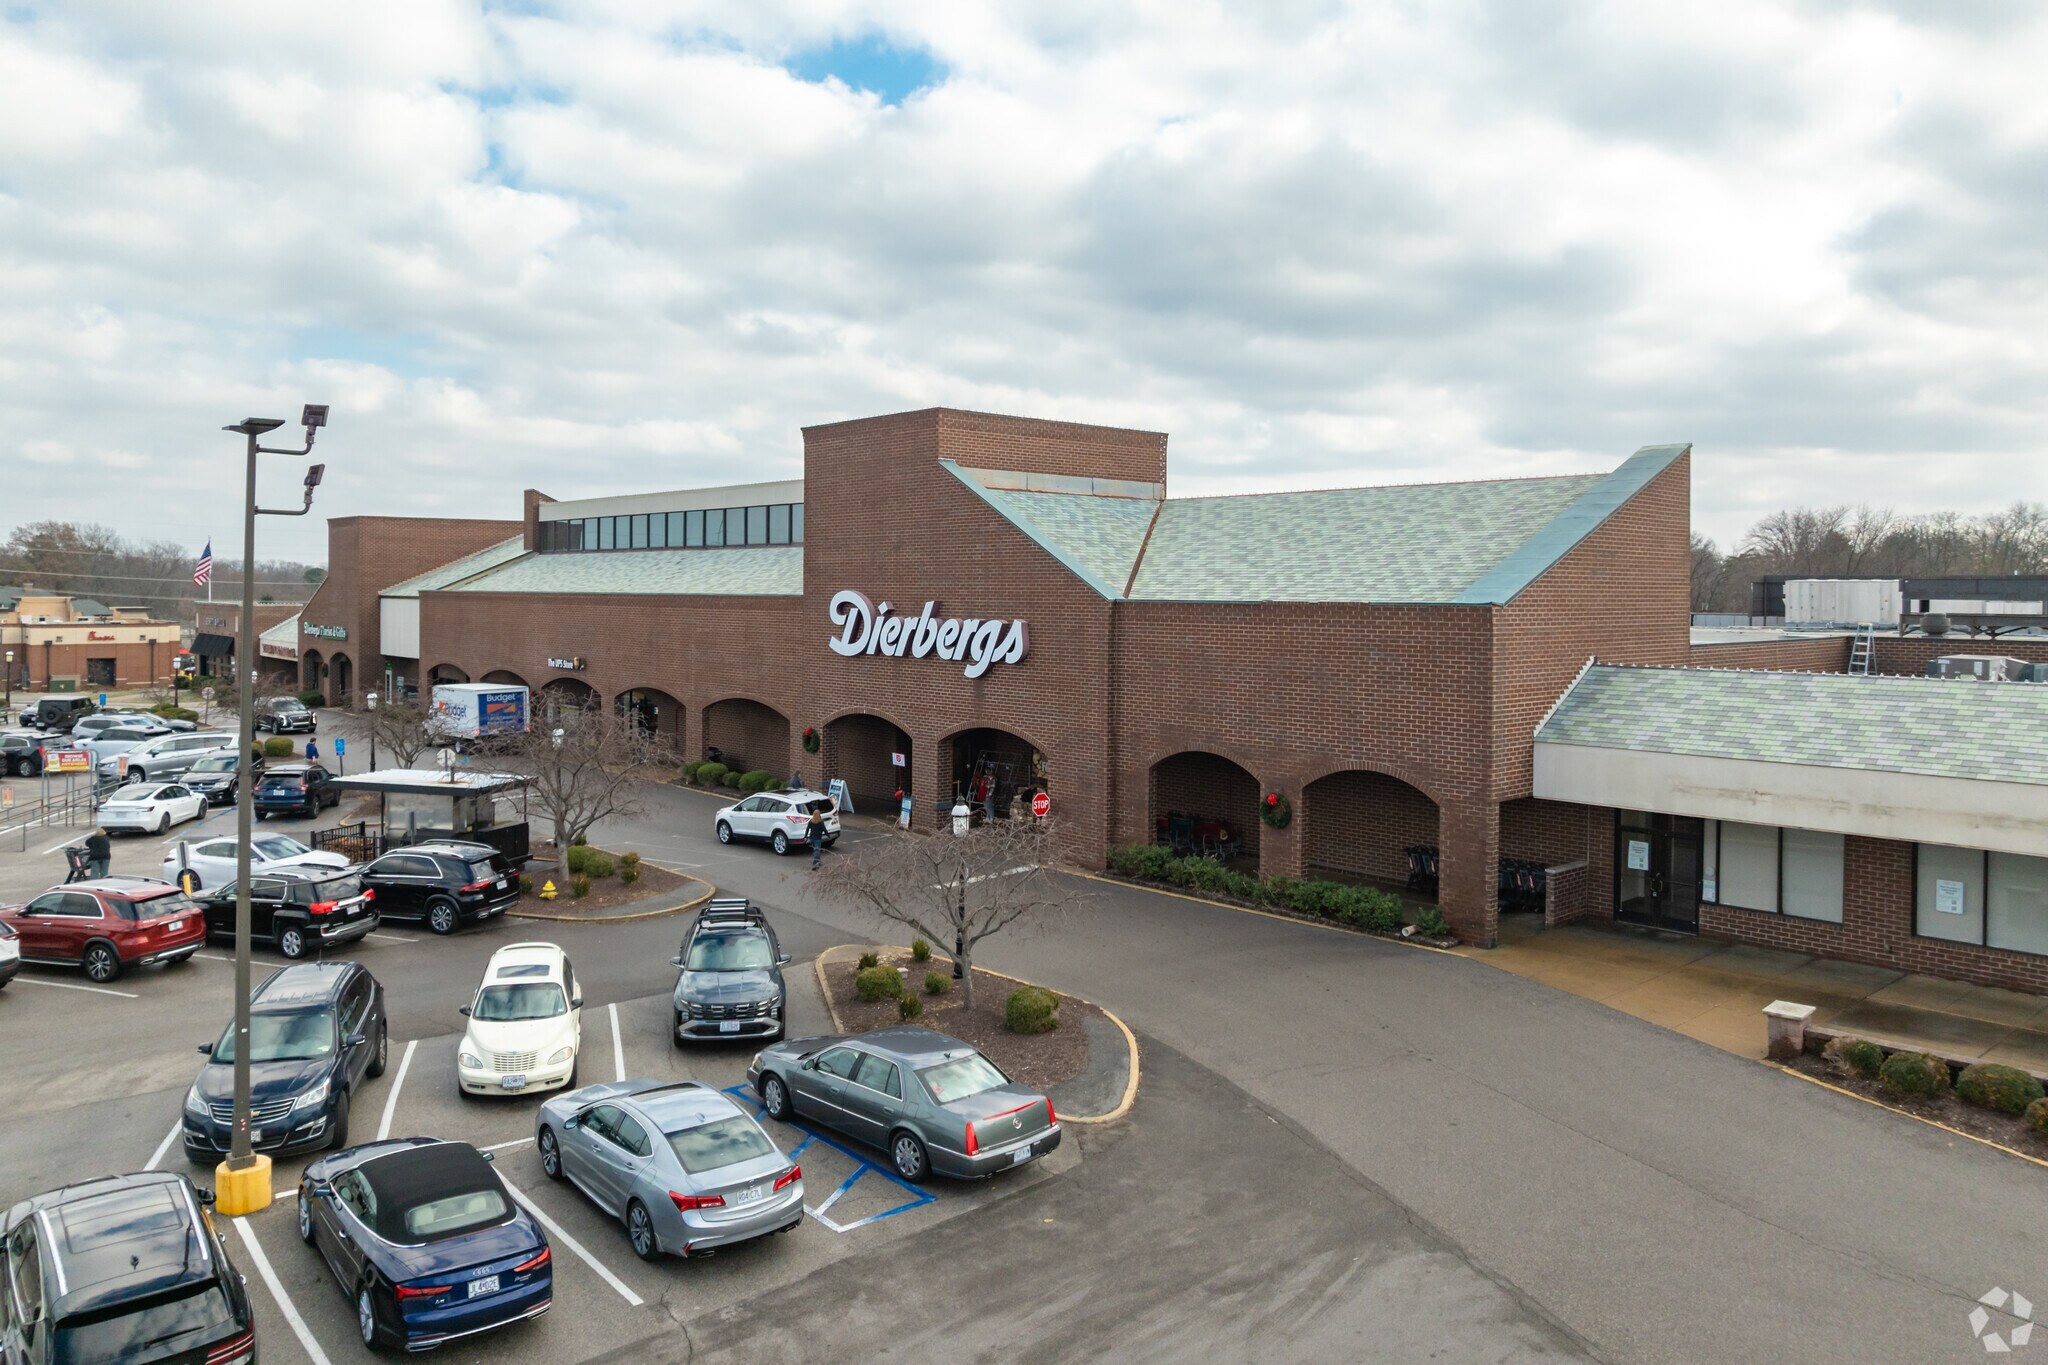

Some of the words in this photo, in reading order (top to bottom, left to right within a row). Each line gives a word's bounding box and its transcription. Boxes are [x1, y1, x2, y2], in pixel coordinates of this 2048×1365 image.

[829, 590, 1027, 679] Dierbergs
[555, 659, 563, 668] UPS
[563, 660, 573, 669] Store
[486, 693, 516, 703] Budget
[1033, 800, 1049, 810] STOP
